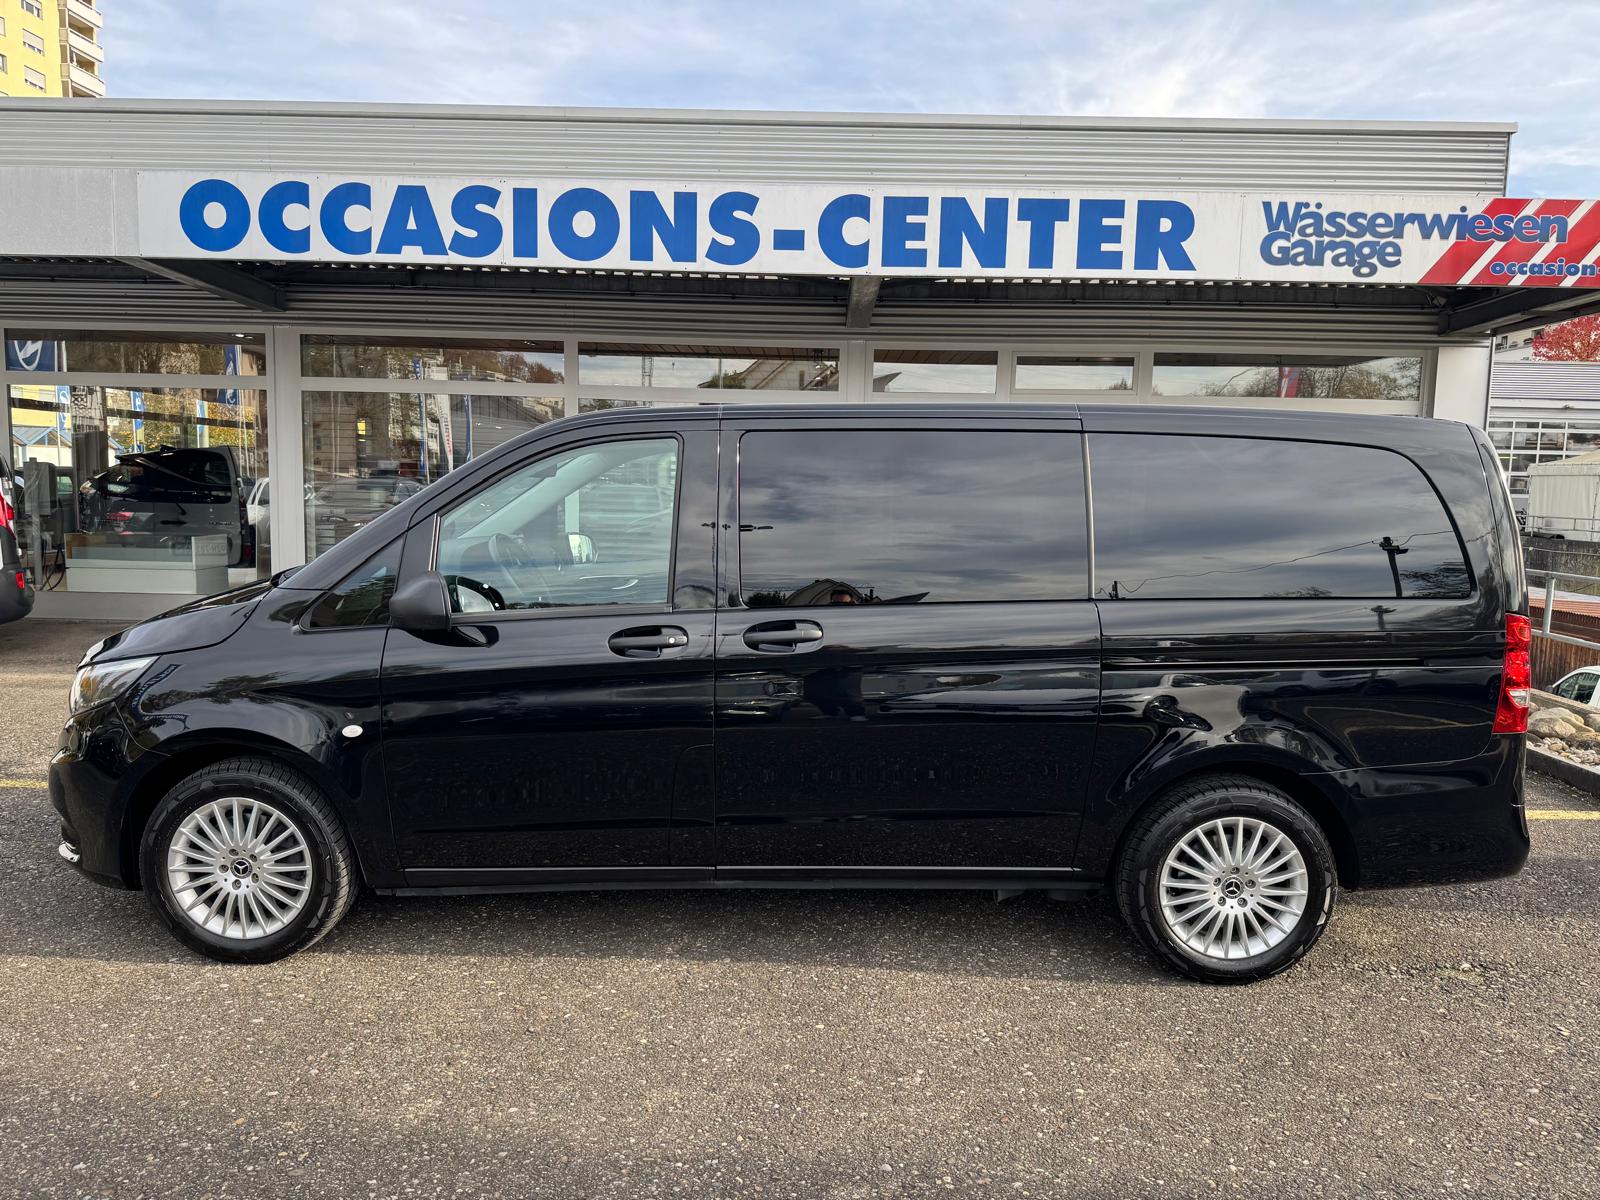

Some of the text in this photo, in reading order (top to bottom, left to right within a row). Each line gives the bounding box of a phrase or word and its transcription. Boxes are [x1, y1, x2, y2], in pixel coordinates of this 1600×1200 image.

[179, 178, 1196, 271] OCCASIONS-CENTER
[1261, 200, 1568, 243] Wässerwiesen
[1259, 231, 1402, 278] Garage
